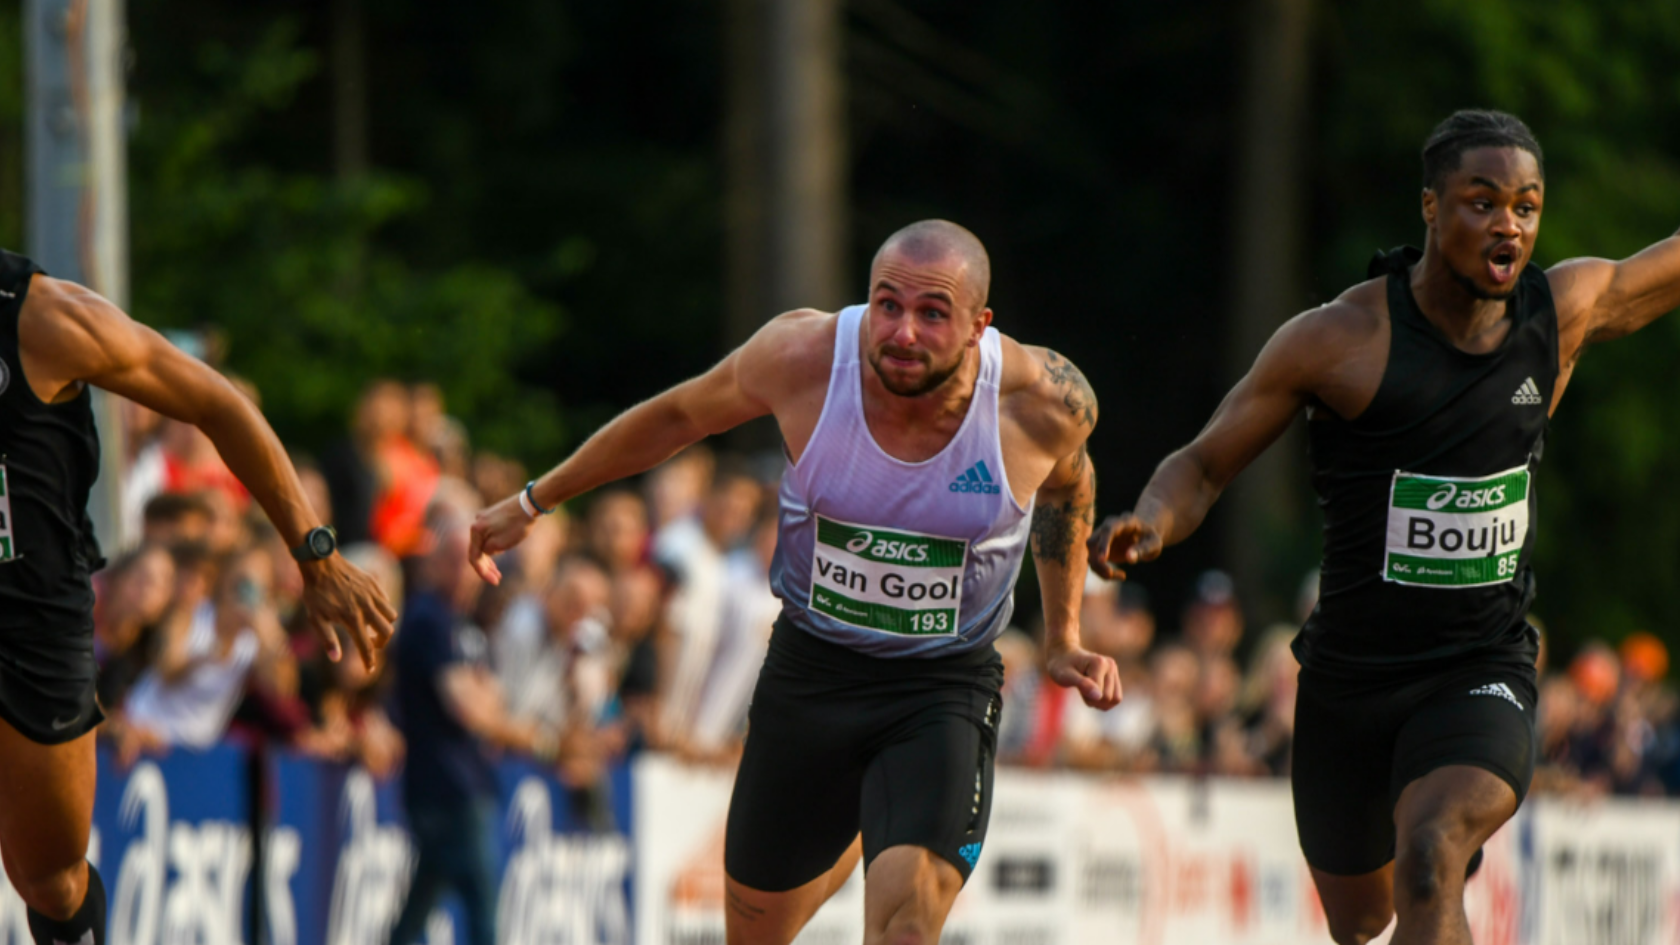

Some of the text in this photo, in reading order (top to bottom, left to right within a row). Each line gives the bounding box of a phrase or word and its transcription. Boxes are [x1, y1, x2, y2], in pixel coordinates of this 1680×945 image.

[1511, 394, 1542, 405] adidas
[949, 480, 1001, 495] adidas
[1455, 484, 1507, 508] asics
[1407, 516, 1516, 558] Bouju
[871, 539, 930, 562] asics
[1497, 554, 1518, 577] 85
[816, 556, 959, 601] van Gool
[909, 612, 949, 632] 193
